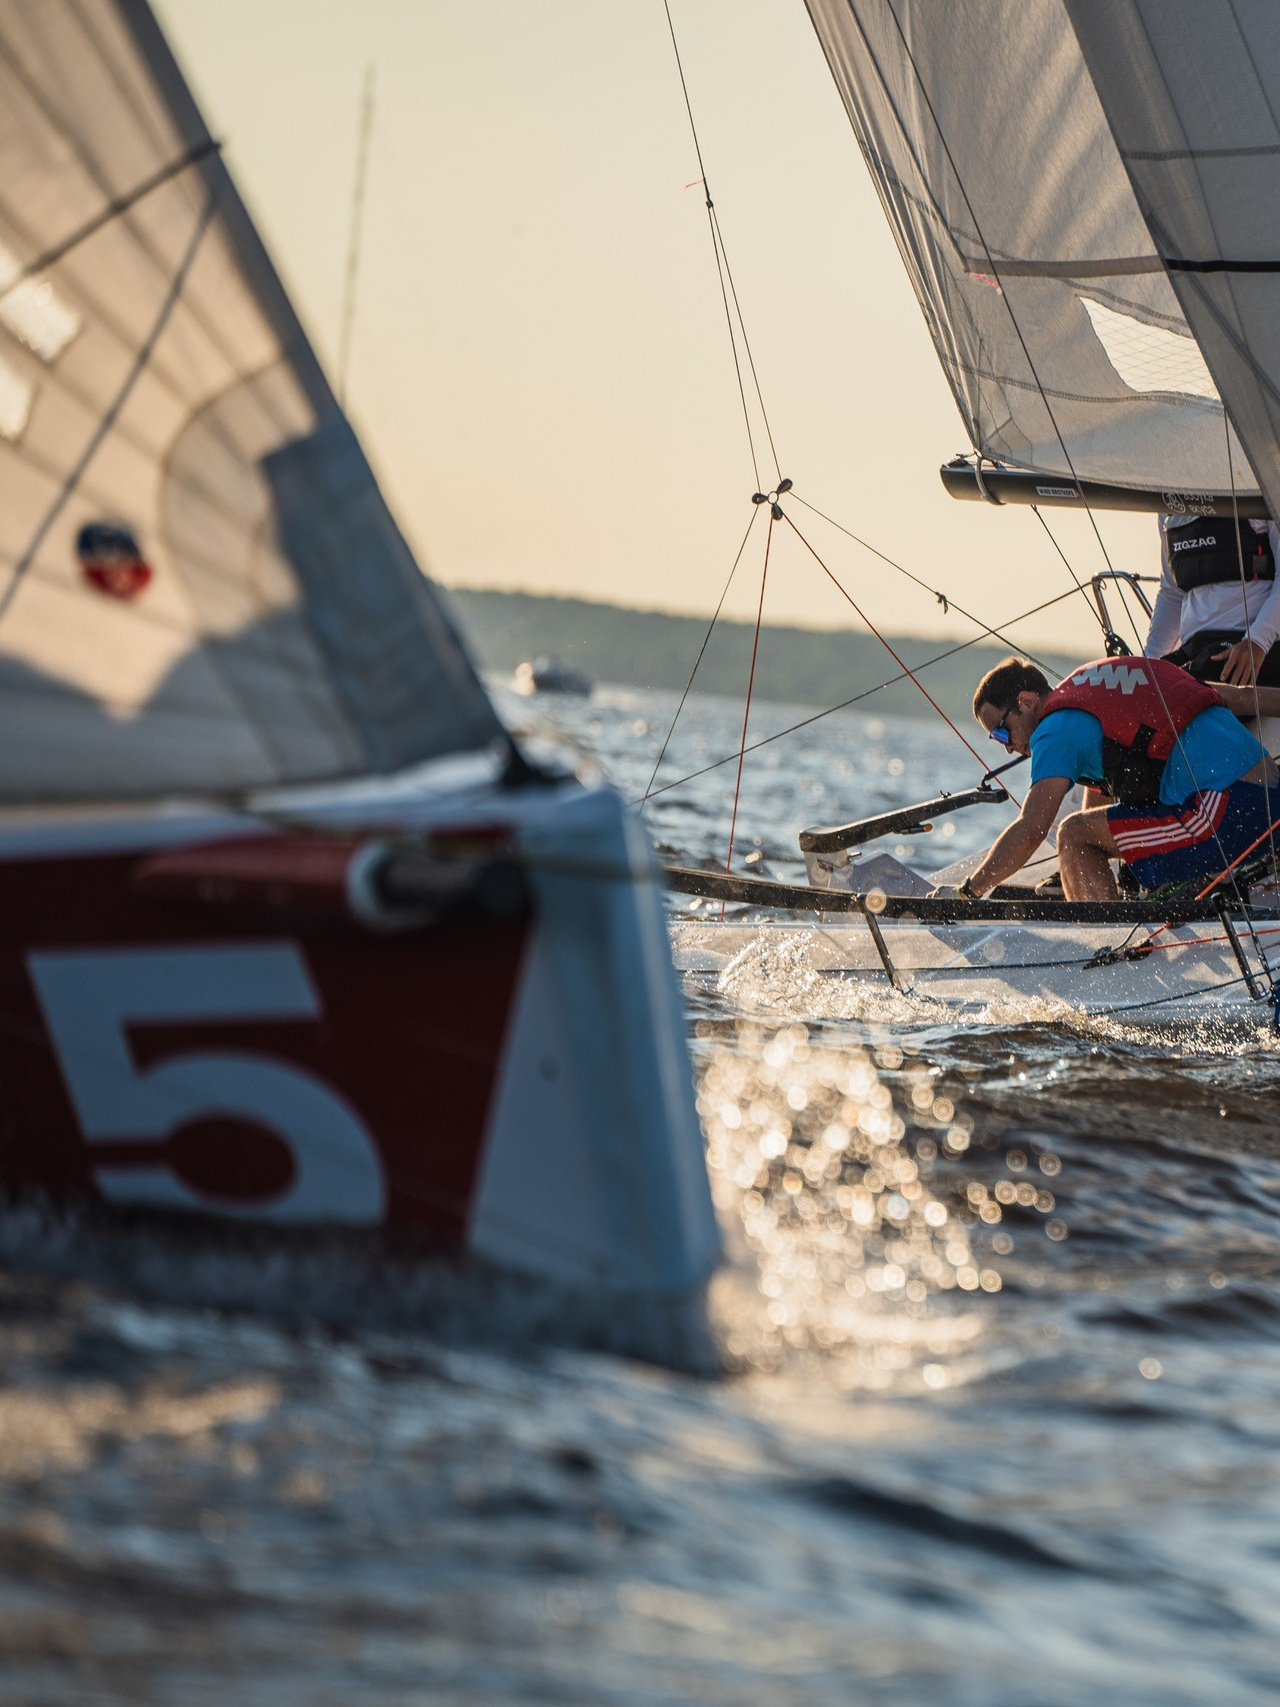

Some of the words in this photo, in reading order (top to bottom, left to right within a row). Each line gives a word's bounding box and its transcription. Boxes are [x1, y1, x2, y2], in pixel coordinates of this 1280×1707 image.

[1189, 504, 1217, 516] вкуса
[1173, 536, 1217, 552] ZIGZAG
[26, 939, 387, 1225] 5
